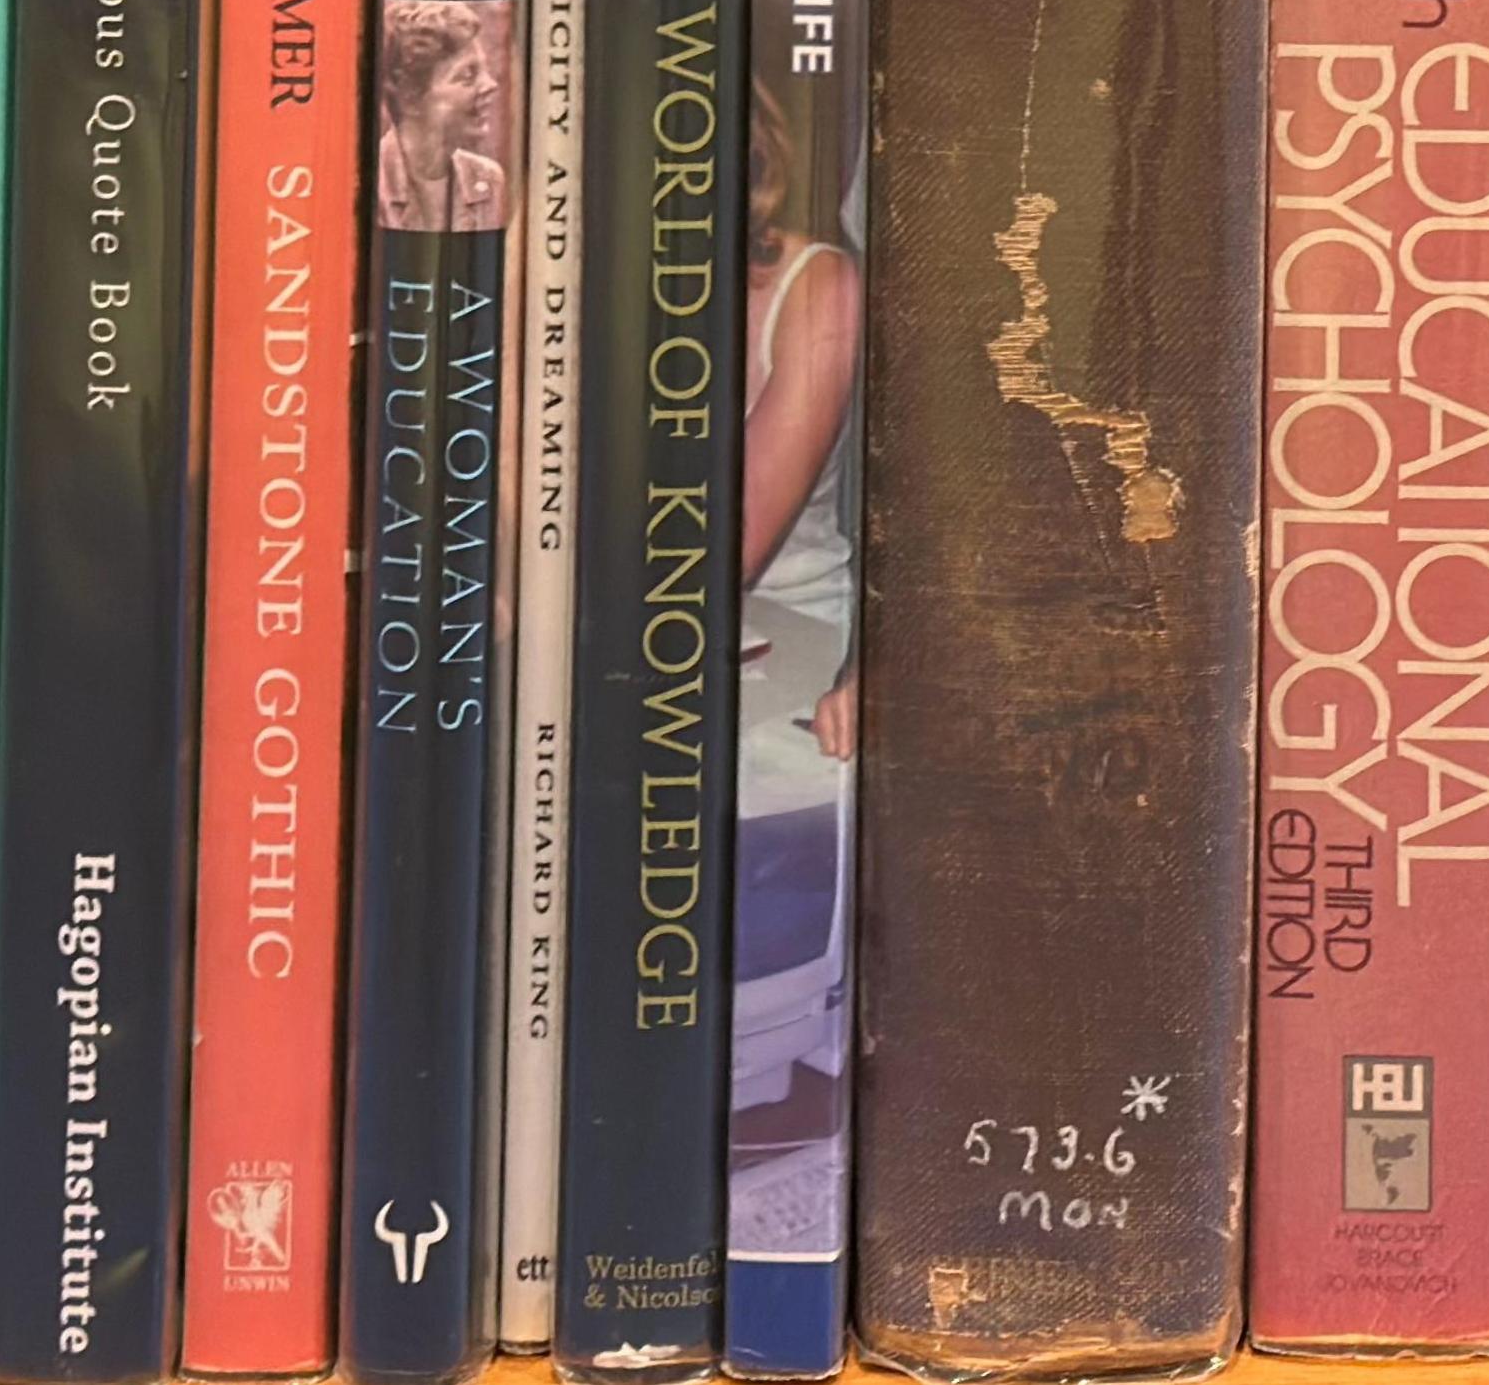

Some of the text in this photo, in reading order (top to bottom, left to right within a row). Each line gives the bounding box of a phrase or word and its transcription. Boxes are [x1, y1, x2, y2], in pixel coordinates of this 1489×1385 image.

[86, 95, 136, 257] Quote
[545, 160, 567, 261] AND
[651, 6, 718, 317] WORLD
[86, 281, 131, 410] Book
[540, 288, 566, 551] DREAMING
[649, 337, 711, 439] OF
[376, 278, 435, 735] EDUCATION
[437, 280, 495, 730] A WOMAN'S
[1268, 42, 1397, 832] PSYCHOLOGY
[247, 165, 313, 979] SANDSTONE GOTHIC
[636, 481, 707, 1030] KNOWLEDGE
[529, 722, 556, 1040] RICHARD KING
[1267, 807, 1316, 1001] EDITION
[1323, 835, 1373, 973] THIRD
[57, 853, 115, 1354] Hagopian Institute
[225, 1160, 292, 1177] ALLEN
[964, 1119, 1137, 1175] 573.6
[223, 1275, 291, 1291] UNWIN
[517, 1255, 549, 1281] ett
[583, 1283, 606, 1308] &
